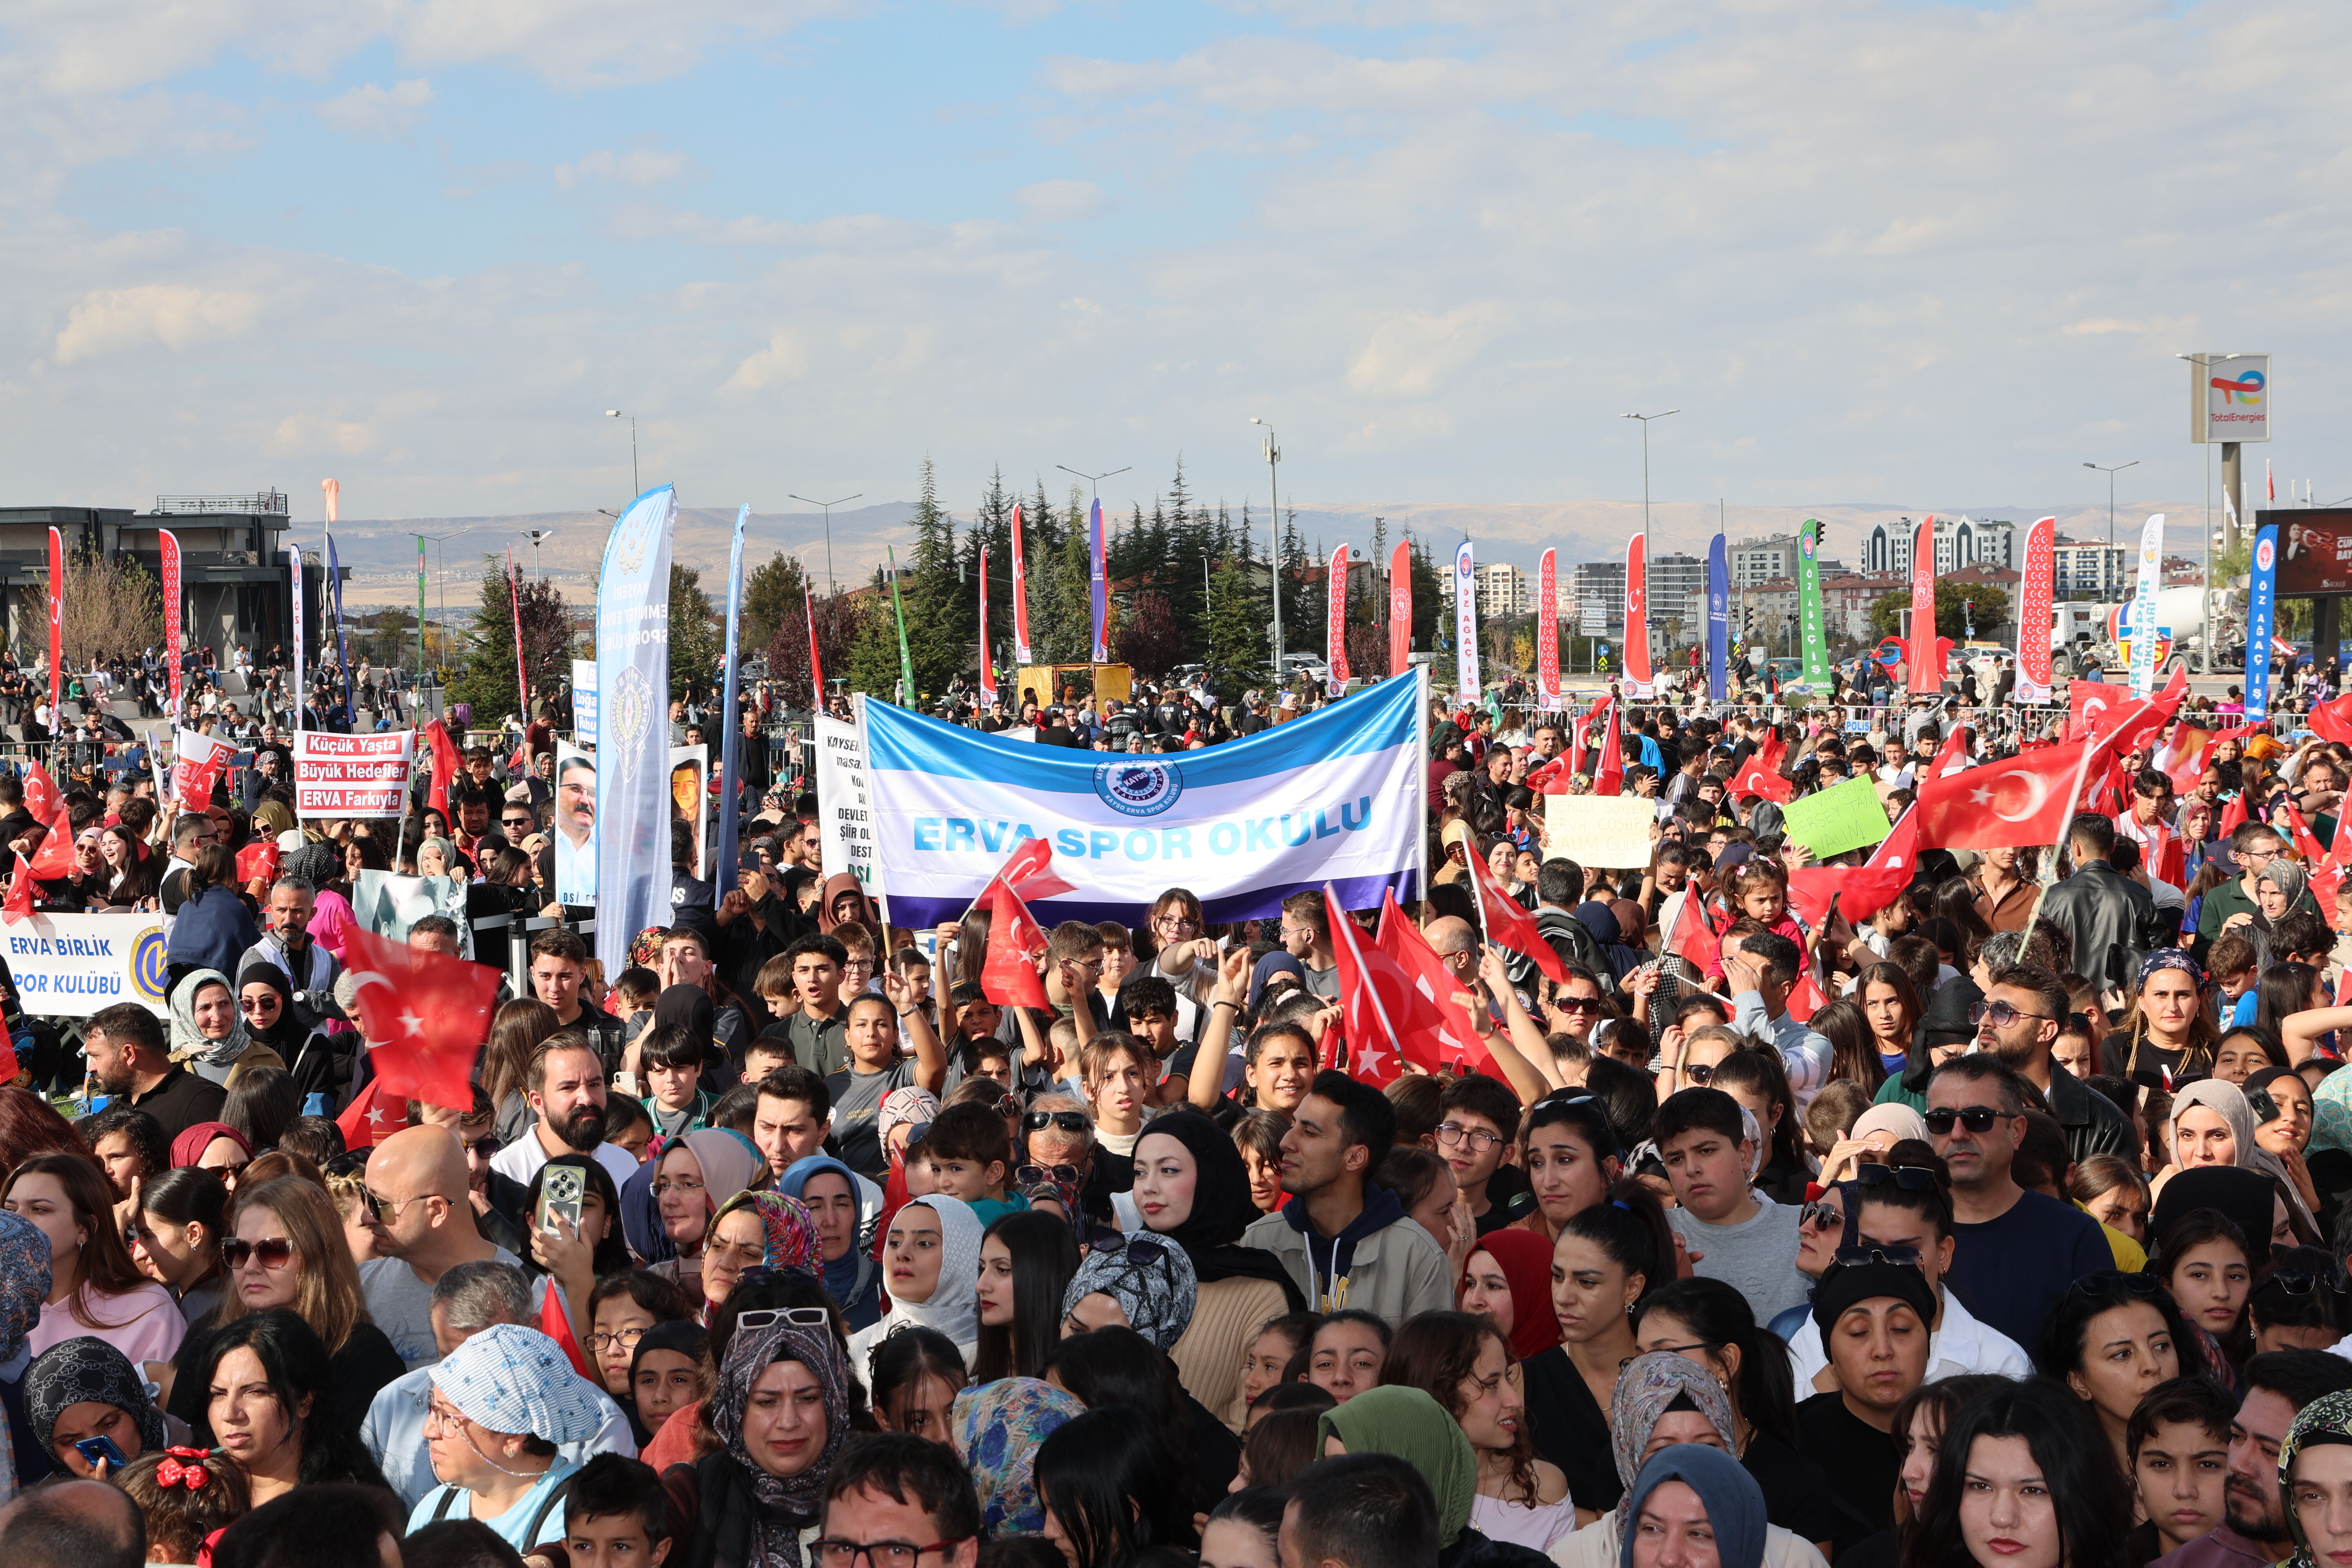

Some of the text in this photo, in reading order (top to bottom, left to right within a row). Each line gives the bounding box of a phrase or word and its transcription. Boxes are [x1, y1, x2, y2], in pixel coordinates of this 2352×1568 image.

[2210, 413, 2265, 423] TotalEnergies
[2258, 581, 2267, 605] ÖZ
[2134, 580, 2149, 637] SPOR
[1463, 587, 1474, 686] ÖZ AĞAÇ İŞ
[2143, 603, 2156, 666] OKULLARI
[2254, 613, 2265, 666] AĞAÇ
[1811, 652, 1821, 675] İŞ
[2252, 673, 2262, 699] İŞ
[309, 736, 397, 755] Küçük Yaşta
[299, 762, 405, 782] Büyük Hedefler
[1123, 771, 1148, 787] KAYSO
[303, 791, 398, 809] ERVA Farkıyla
[1105, 794, 1125, 810] KAYSO
[1147, 803, 1165, 813] SPOR
[1785, 778, 1864, 822] SEN VARSAN
[1844, 788, 1879, 813] TAM
[838, 808, 868, 822] DEVLET
[1550, 817, 1644, 833] ERVA COŞAR
[840, 824, 857, 841] ŞİİR
[1056, 826, 1192, 862] SPOR
[1207, 795, 1372, 857] OKULU
[1607, 836, 1648, 851] GÜLER
[563, 891, 579, 904] DSİ
[10, 933, 113, 956] ERVA BİRLİK
[137, 927, 155, 942] ERVA
[54, 970, 121, 995] KULÜBÜ
[140, 991, 154, 1004] SPOR
